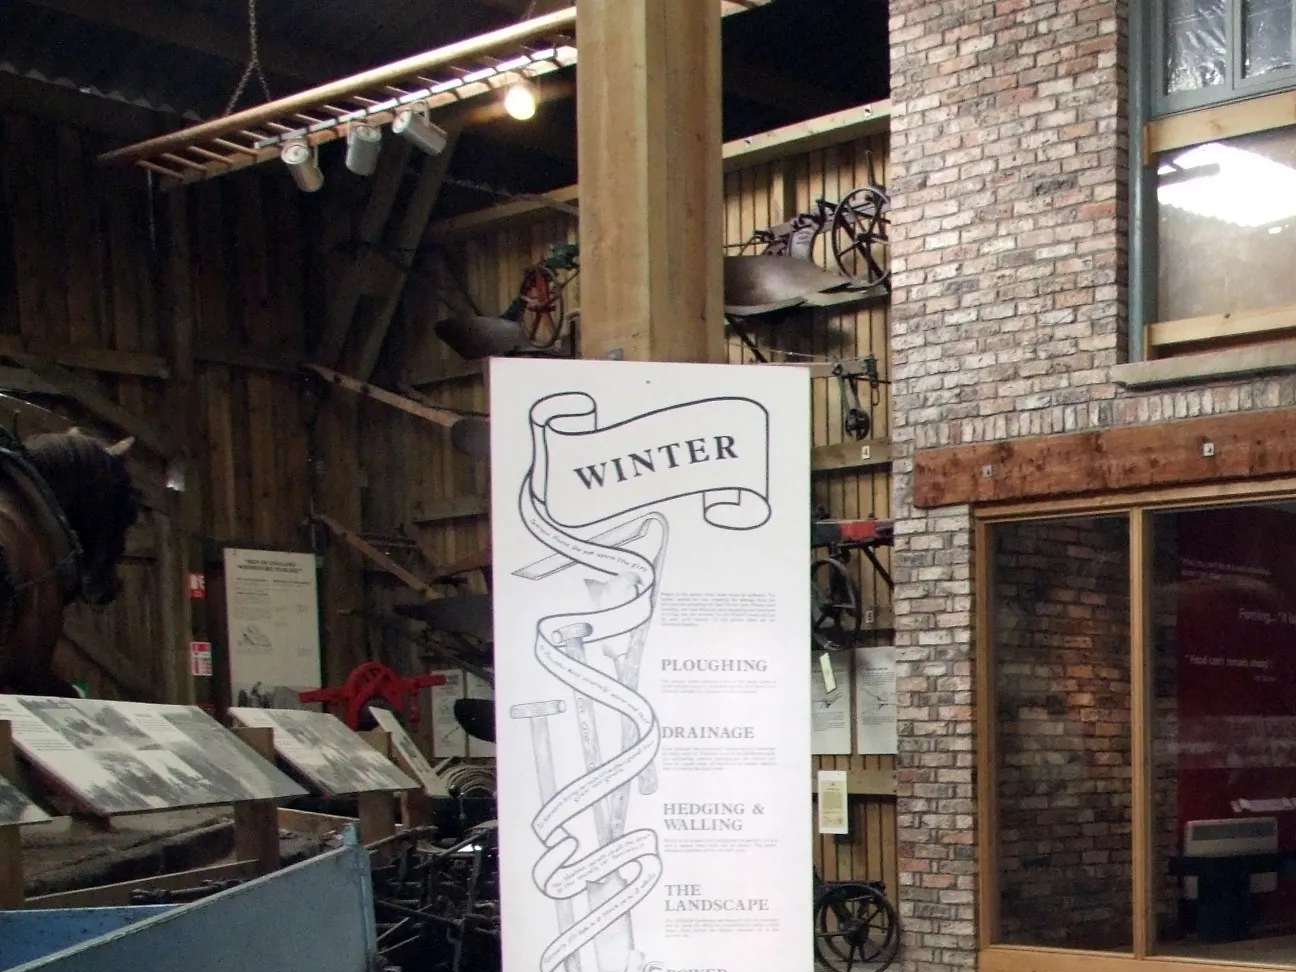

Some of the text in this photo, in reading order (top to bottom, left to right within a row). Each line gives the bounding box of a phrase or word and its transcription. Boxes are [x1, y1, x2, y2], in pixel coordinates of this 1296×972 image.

[573, 434, 739, 491] WINTER
[661, 658, 768, 672] PLOUGHING
[662, 726, 755, 739] DRAINAGE
[663, 802, 765, 816] HEDGING &
[664, 818, 743, 831] WALLING
[665, 883, 702, 897] THE
[665, 899, 769, 912] LANDSCAPE
